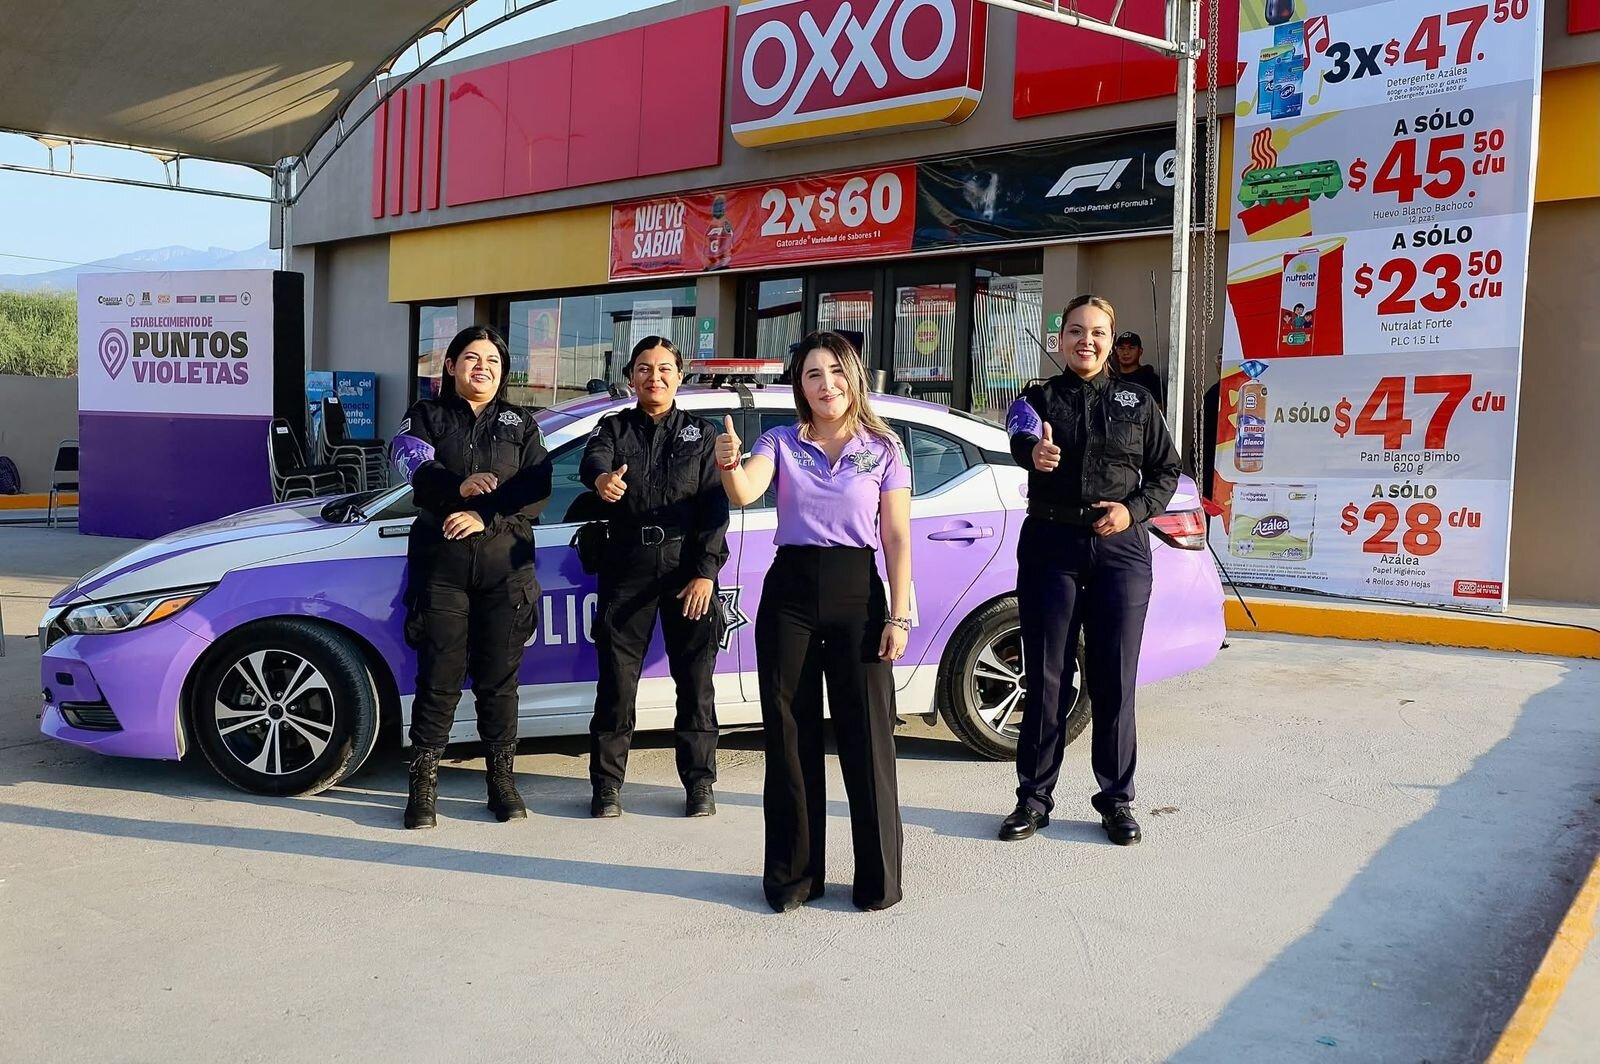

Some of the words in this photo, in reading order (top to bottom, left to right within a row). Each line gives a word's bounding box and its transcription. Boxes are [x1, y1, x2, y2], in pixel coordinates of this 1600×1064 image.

[1493, 0, 1530, 23] 50
[742, 0, 957, 114] OXXO
[1386, 72, 1435, 88] Detergente
[1437, 67, 1468, 79] Azálea
[1446, 77, 1468, 86] GRATIS
[1394, 91, 1425, 101] Detergente
[1393, 119, 1408, 136] A
[1414, 107, 1474, 133] SÓLO
[1473, 129, 1505, 153] 50
[1472, 153, 1505, 175] c/u
[1064, 206, 1087, 214] Official
[1087, 204, 1111, 213] Partner
[1112, 202, 1120, 210] of
[1120, 199, 1149, 209] Formula
[1373, 209, 1400, 220] Huevo
[1402, 205, 1432, 216] Blanco
[1435, 201, 1474, 213] Bachoco
[635, 202, 685, 233] NUEVO
[1418, 214, 1435, 224] pzas
[631, 229, 684, 259] SABOR
[811, 234, 838, 244] Variedad
[838, 234, 846, 242] de
[847, 232, 872, 241] Sabores
[1391, 232, 1407, 250] A
[1412, 223, 1473, 248] SÓLO
[1468, 249, 1502, 276] 50
[1285, 272, 1317, 282] nutralat
[1468, 277, 1503, 299] c/u
[130, 316, 199, 328] ESTABLECIMIENTO
[201, 316, 213, 328] DE
[1380, 319, 1422, 332] Nutralat
[1425, 318, 1453, 329] Forte
[132, 331, 249, 359] PUNTOS
[1390, 336, 1410, 346] PLC
[1412, 335, 1426, 345] 1.5
[1429, 335, 1440, 344] Lt
[131, 360, 249, 385] VIOLETAS
[339, 378, 351, 387] ciel
[359, 378, 372, 387] ciel
[1273, 407, 1284, 424] A
[1287, 401, 1331, 423] SÓLO
[1471, 391, 1506, 411] c/u
[1243, 438, 1264, 446] Blanco
[1360, 451, 1380, 462] Pan
[1383, 450, 1421, 463] Blanco
[1423, 450, 1461, 463] Bimbo
[1393, 462, 1414, 473] 620
[1416, 464, 1424, 475] g
[1371, 483, 1384, 498] A
[1388, 480, 1438, 499] SÓLO
[1251, 518, 1289, 536] Azálea
[1340, 501, 1442, 556] $28
[1448, 507, 1482, 528] c/u
[1380, 554, 1420, 566] Azálea
[1372, 566, 1392, 575] Papel
[1393, 567, 1426, 577] Higiénico
[1372, 577, 1394, 586] Rollos
[1395, 579, 1409, 587] 350
[1411, 580, 1431, 589] Hojas
